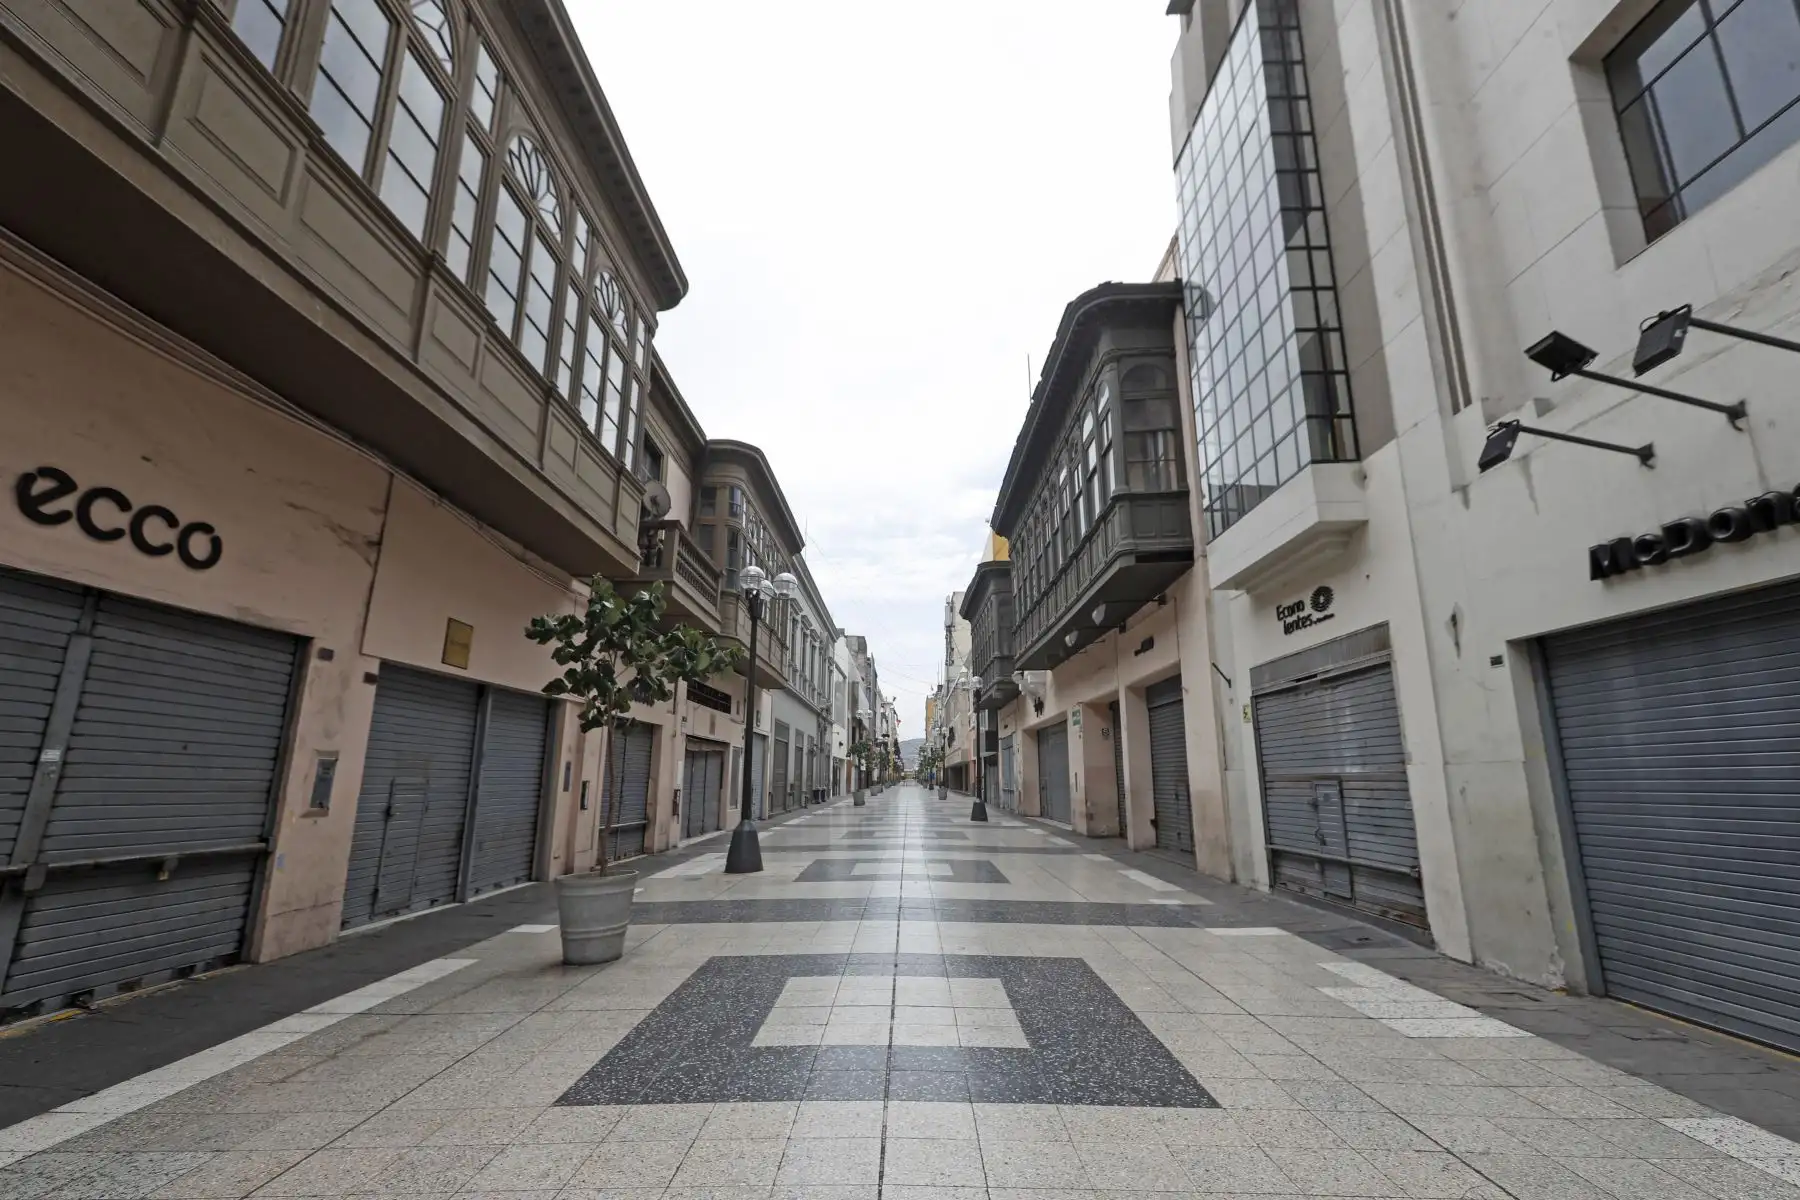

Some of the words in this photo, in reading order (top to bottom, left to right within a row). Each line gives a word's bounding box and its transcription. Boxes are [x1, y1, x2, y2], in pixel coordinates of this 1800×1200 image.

[15, 466, 222, 570] ecco
[1589, 482, 1800, 581] McDon
[1276, 599, 1305, 621] Econo
